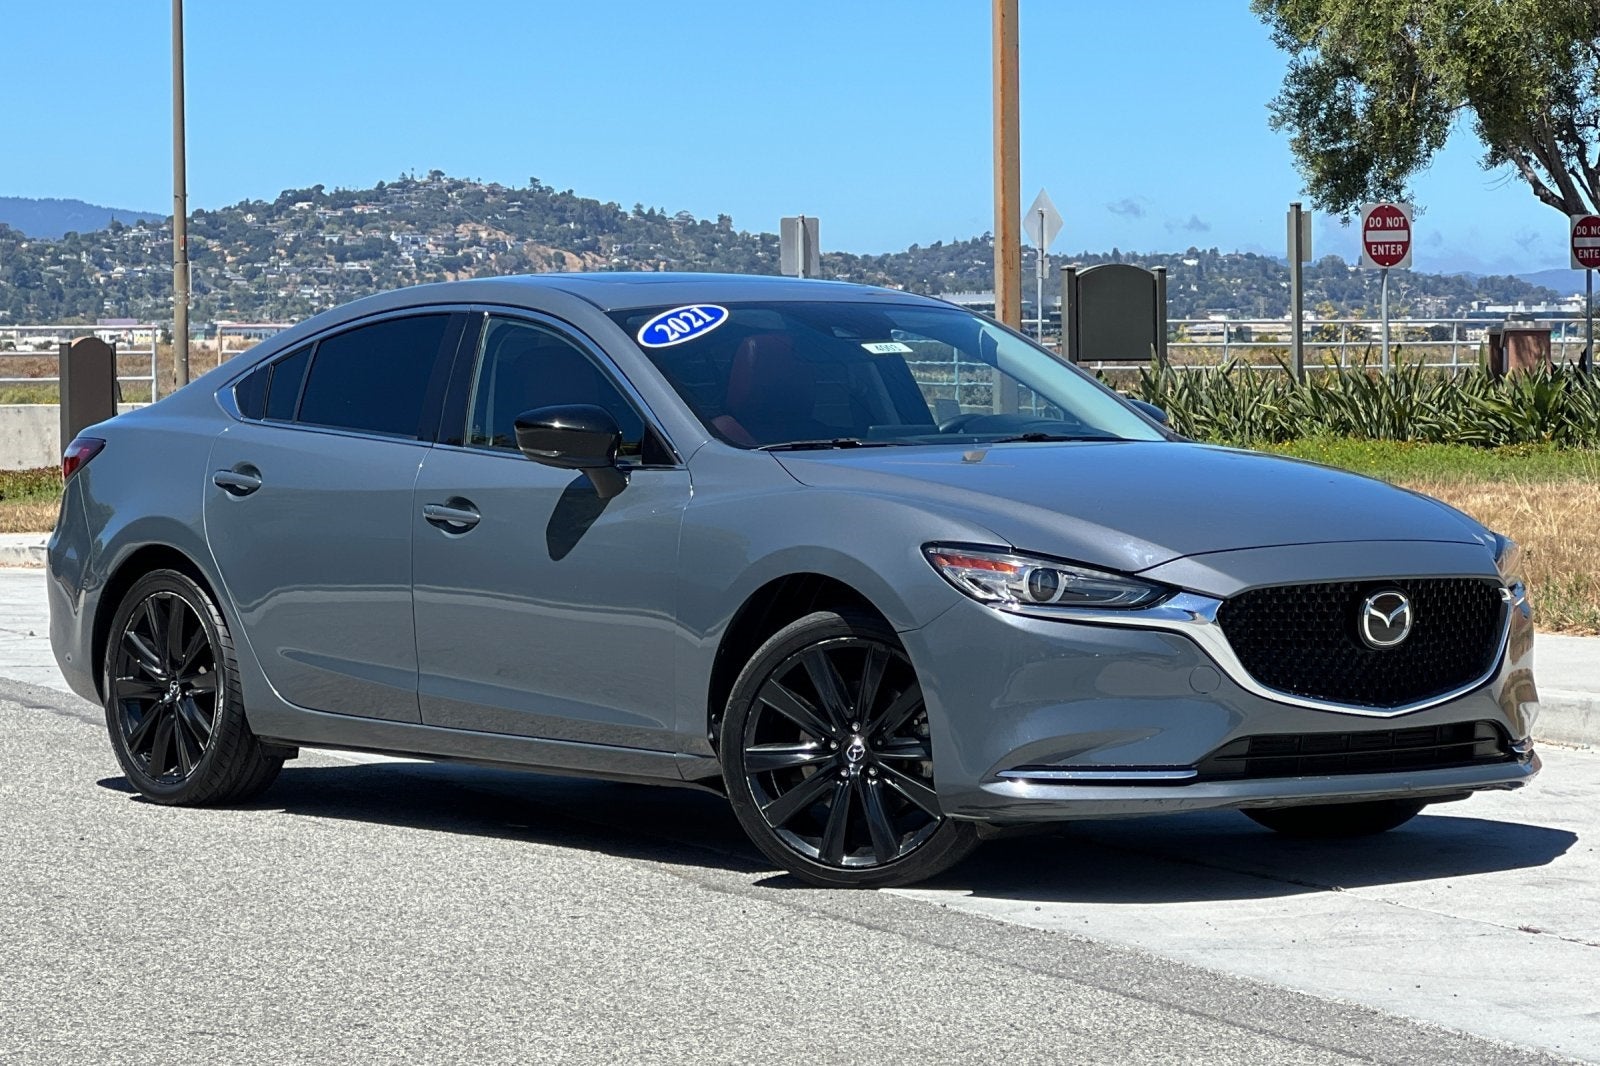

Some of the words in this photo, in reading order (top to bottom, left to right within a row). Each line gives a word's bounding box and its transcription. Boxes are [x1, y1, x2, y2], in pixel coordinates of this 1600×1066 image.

[1369, 216, 1382, 228] DO
[1386, 216, 1405, 228] NOT
[1576, 225, 1588, 235] DO
[1371, 244, 1403, 255] ENTER
[654, 307, 715, 342] 2021
